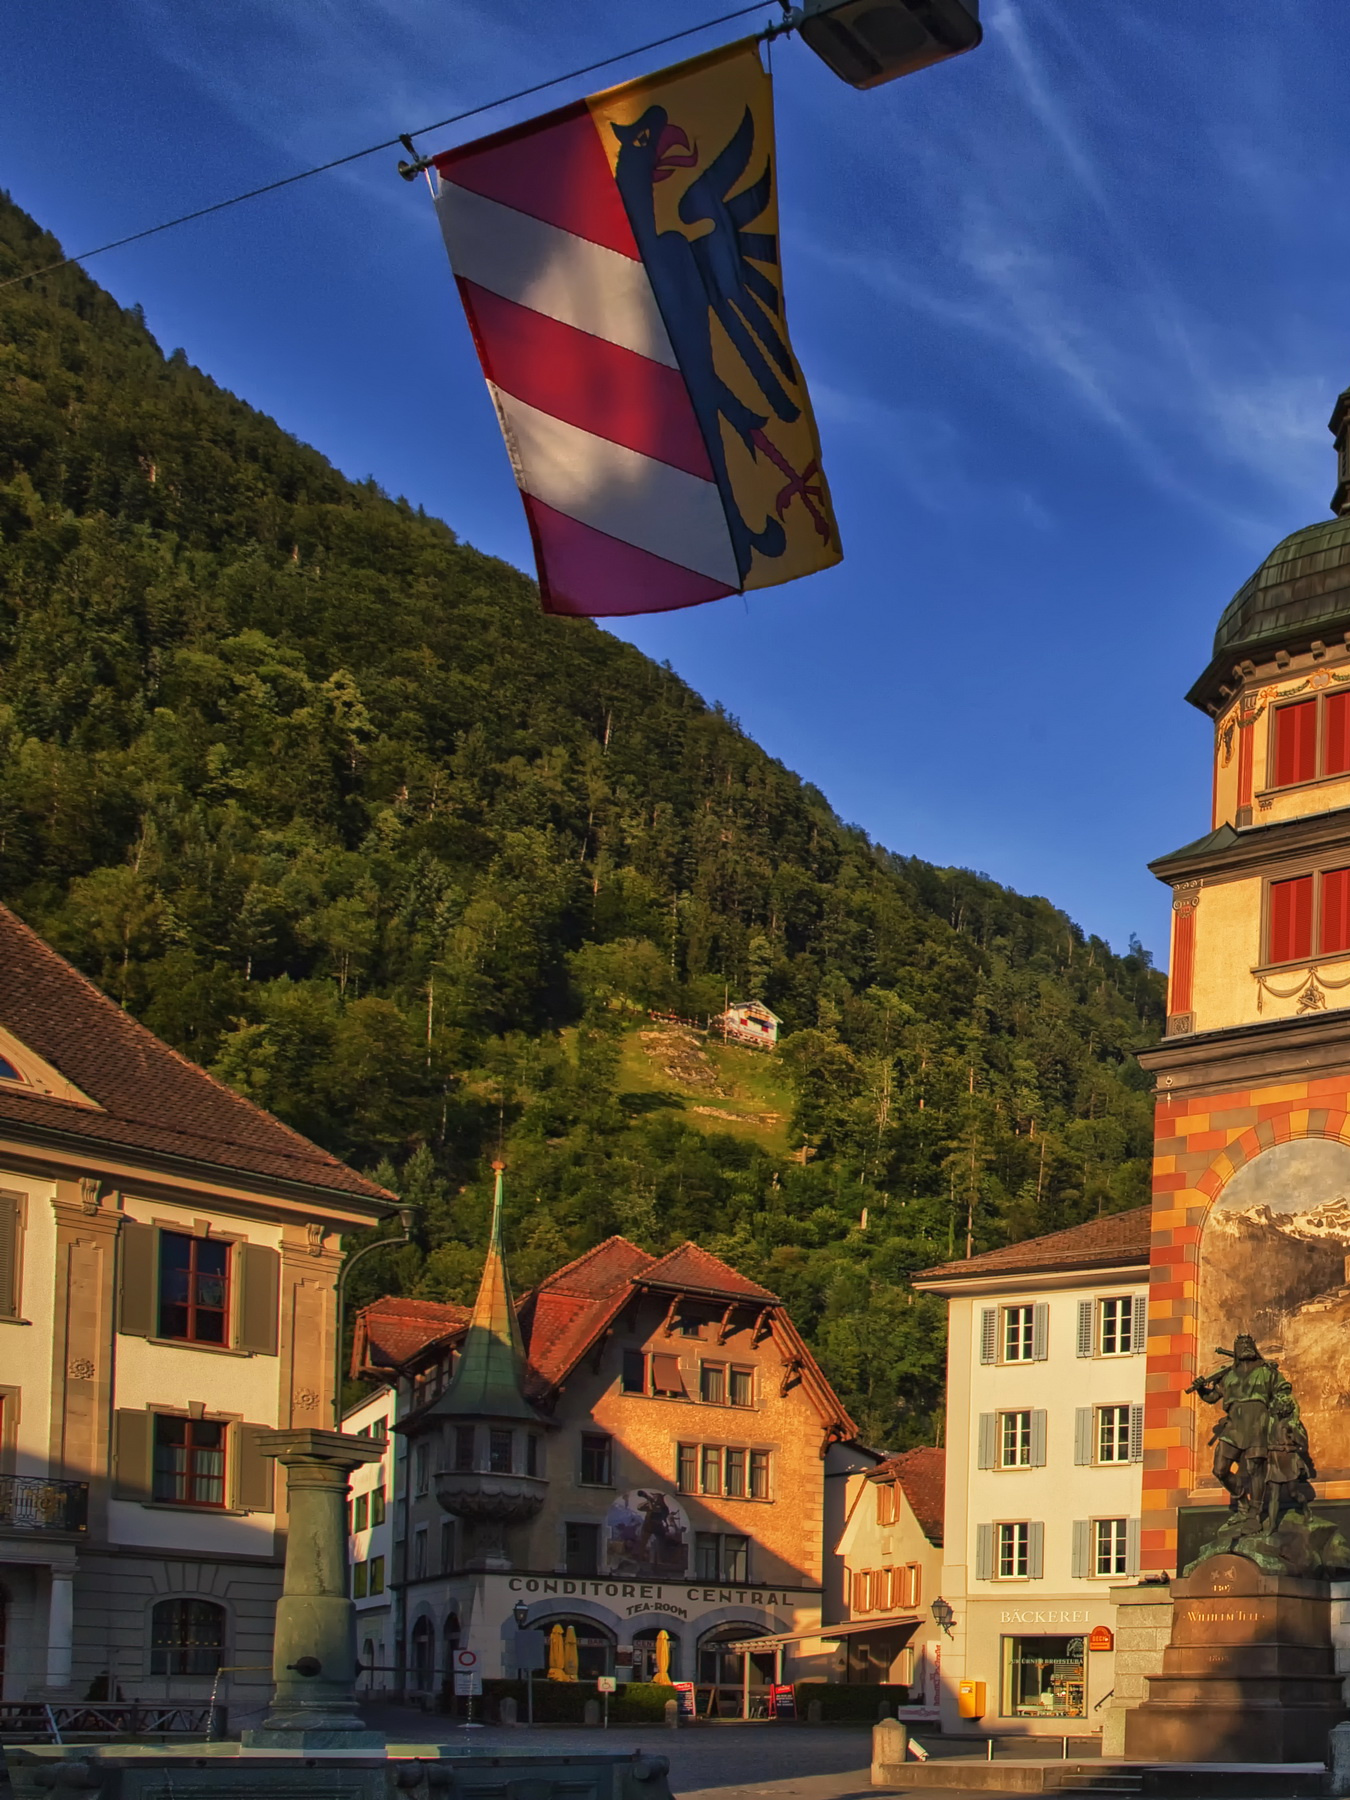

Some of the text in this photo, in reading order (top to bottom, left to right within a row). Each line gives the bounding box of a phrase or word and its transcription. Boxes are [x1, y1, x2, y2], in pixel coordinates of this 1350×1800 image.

[508, 1577, 795, 1606] CONDITOREI CENTRAL
[625, 1601, 688, 1619] TEA-ROOM
[1000, 1608, 1091, 1623] BÄCKEREI
